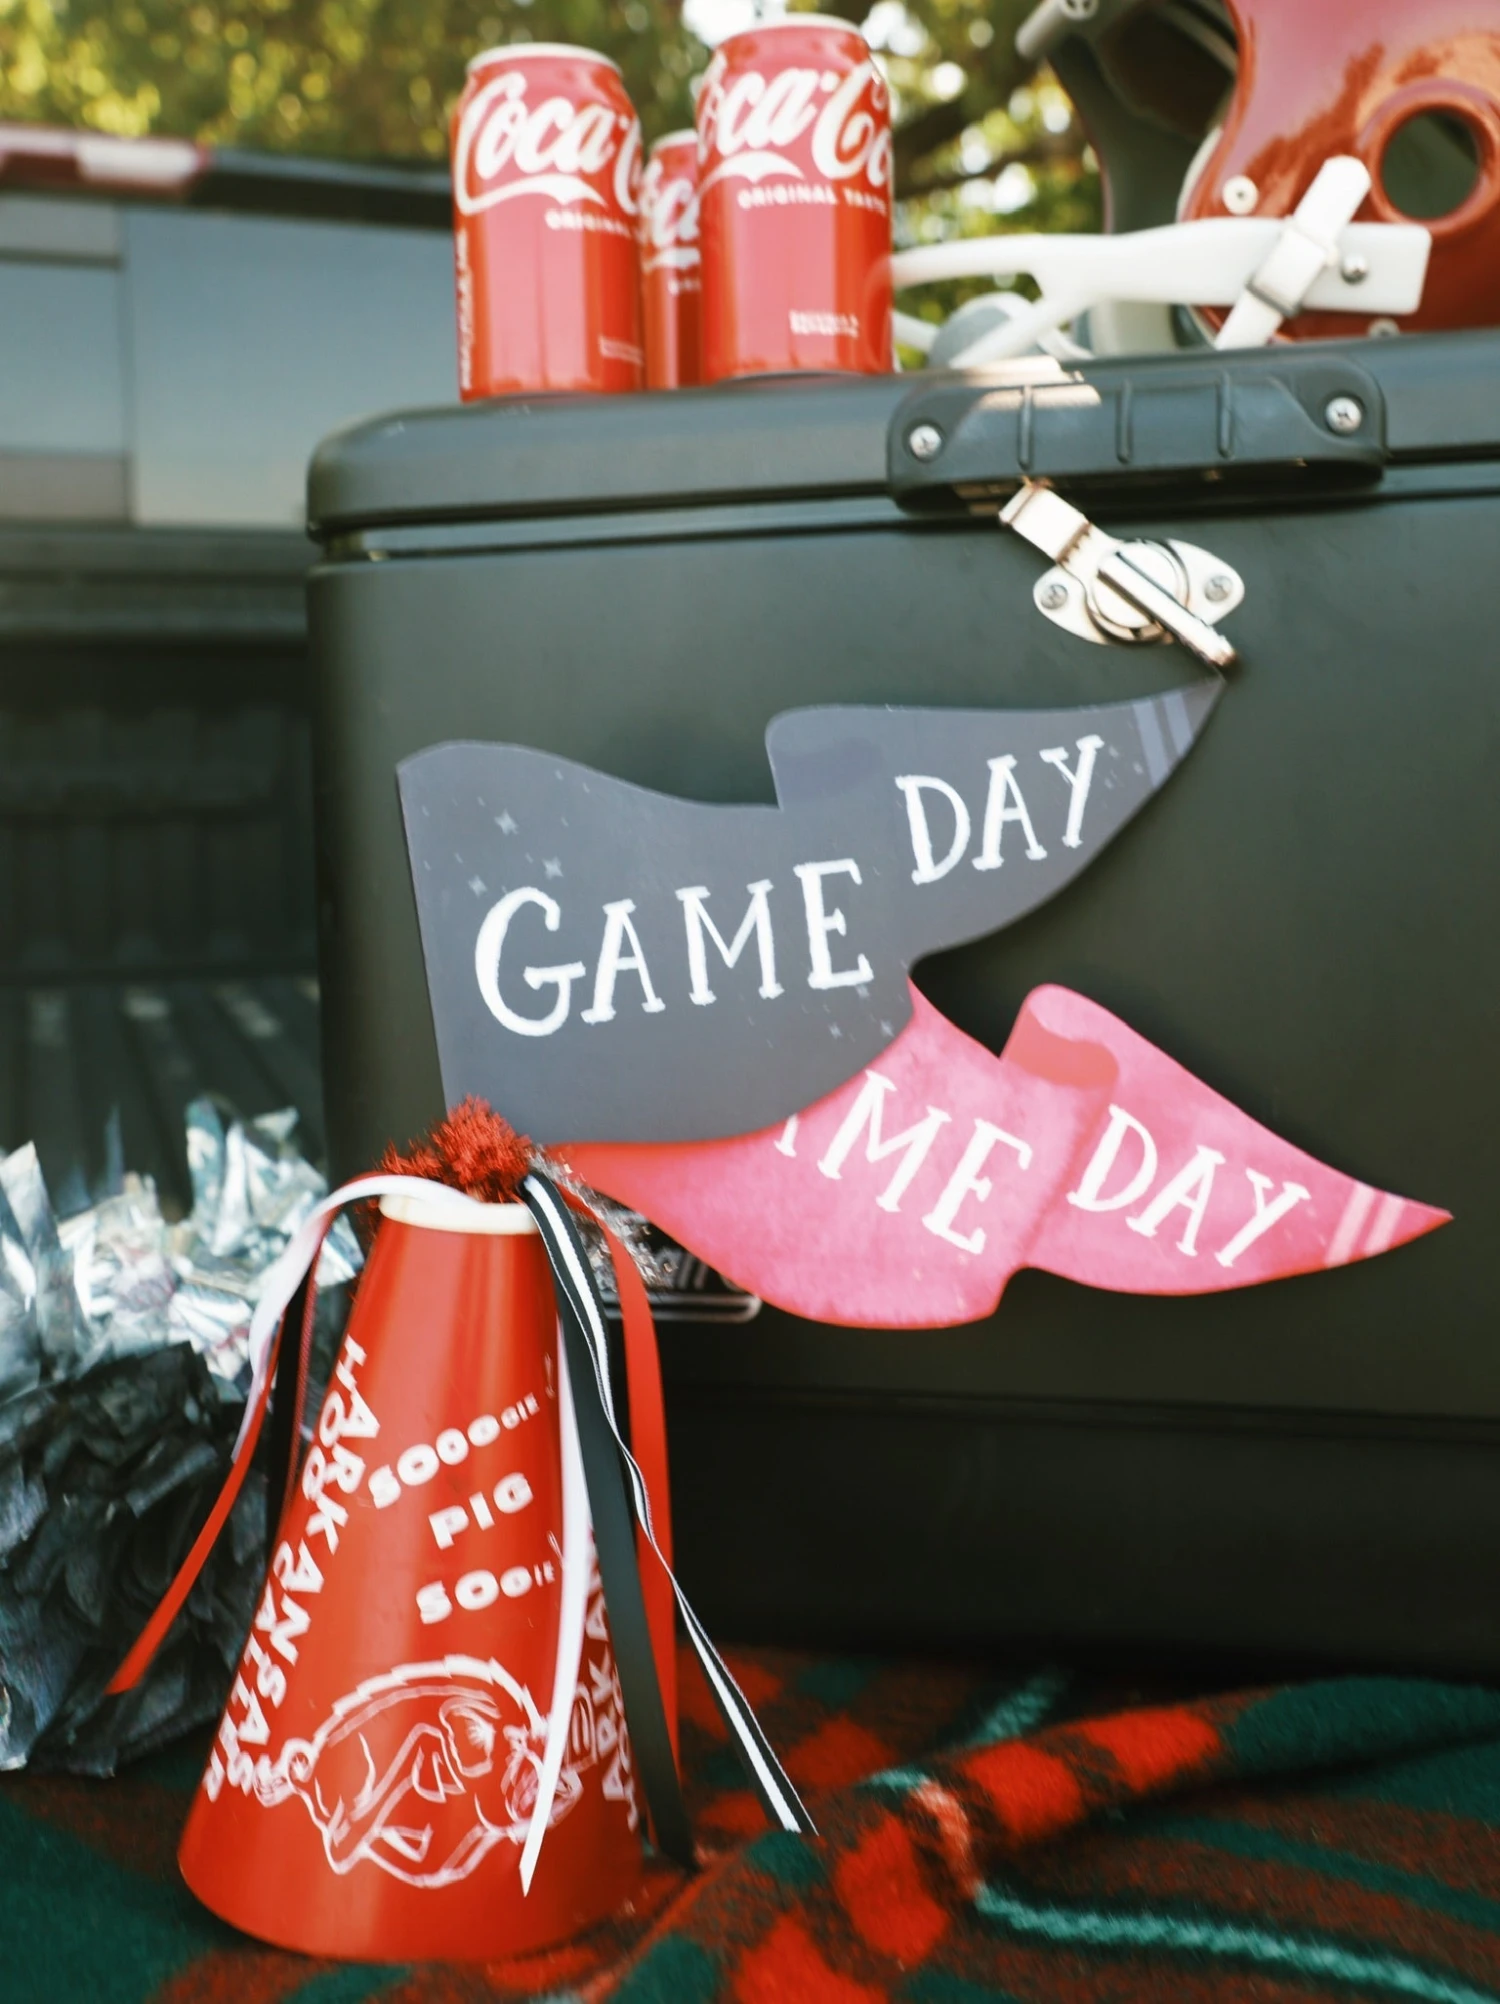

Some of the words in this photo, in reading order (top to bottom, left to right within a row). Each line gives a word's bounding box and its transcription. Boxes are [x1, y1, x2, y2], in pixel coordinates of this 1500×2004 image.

[475, 857, 873, 1037] GAME
[895, 734, 1105, 885] DAY
[774, 1070, 1033, 1255] ME
[1066, 1103, 1311, 1268] DAY
[227, 1384, 381, 1798] ARKANSAS
[428, 1472, 534, 1550] PIG
